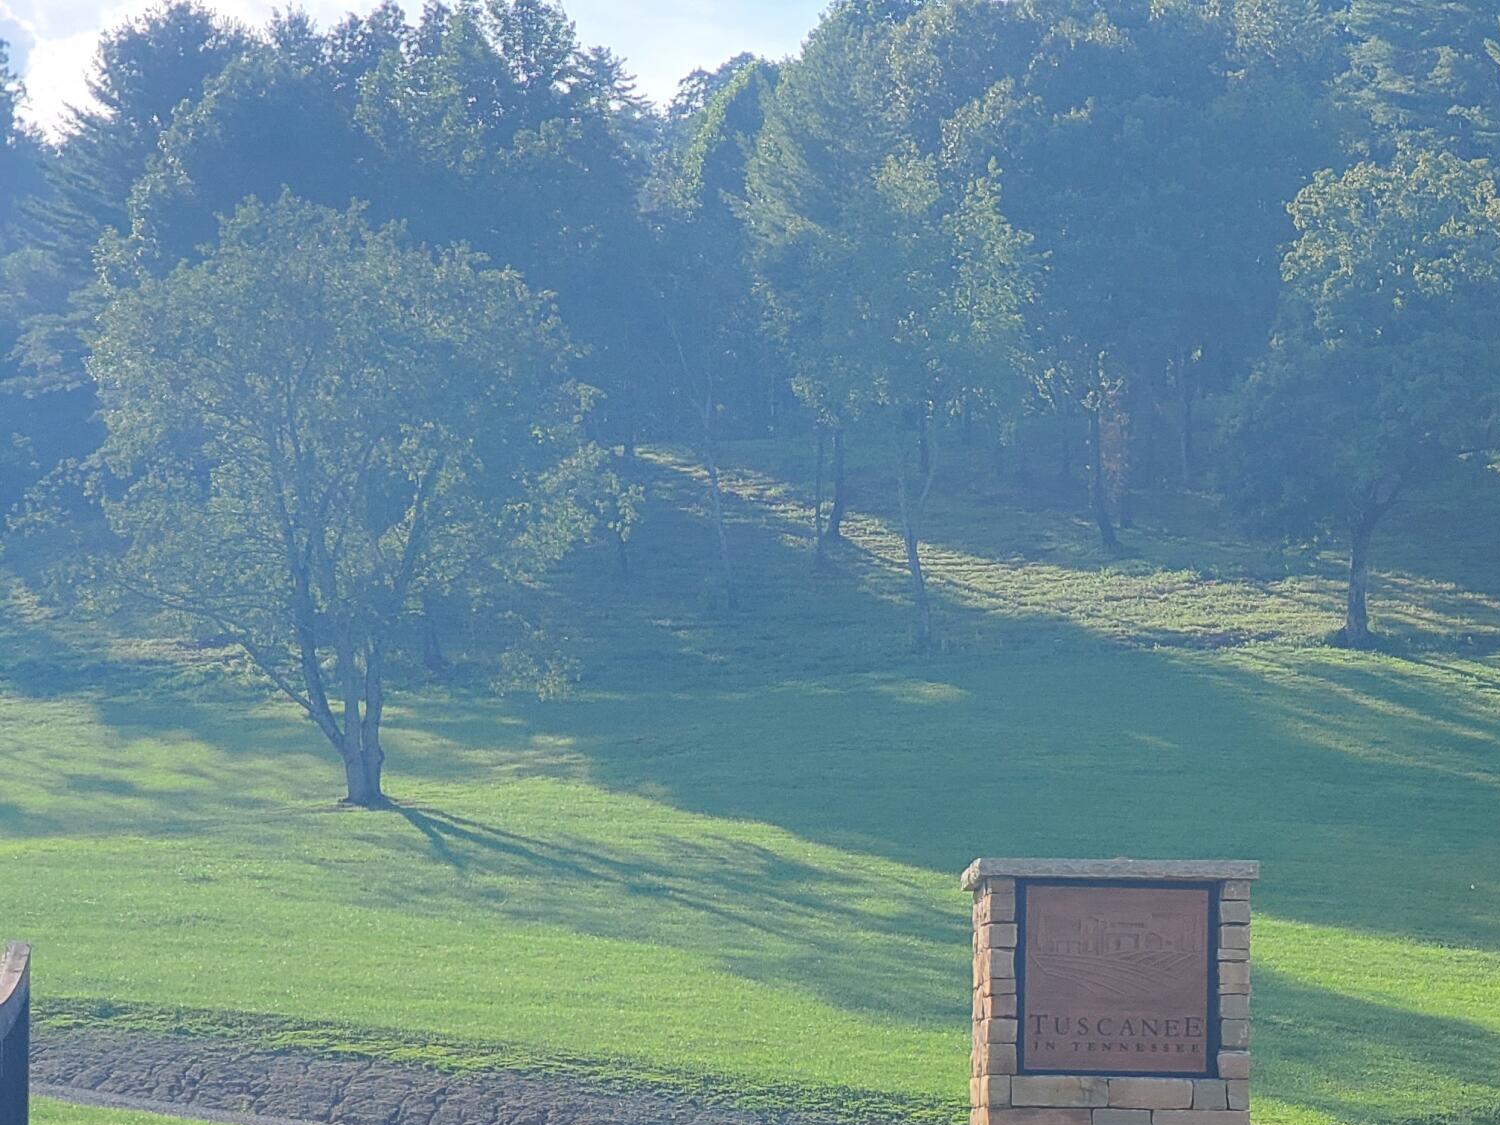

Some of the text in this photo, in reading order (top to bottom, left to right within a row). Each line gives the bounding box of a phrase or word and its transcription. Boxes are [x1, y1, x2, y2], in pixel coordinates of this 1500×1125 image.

[1029, 1013, 1203, 1038] TUSCANEE
[1034, 1041, 1200, 1053] IN TENNESSEE
